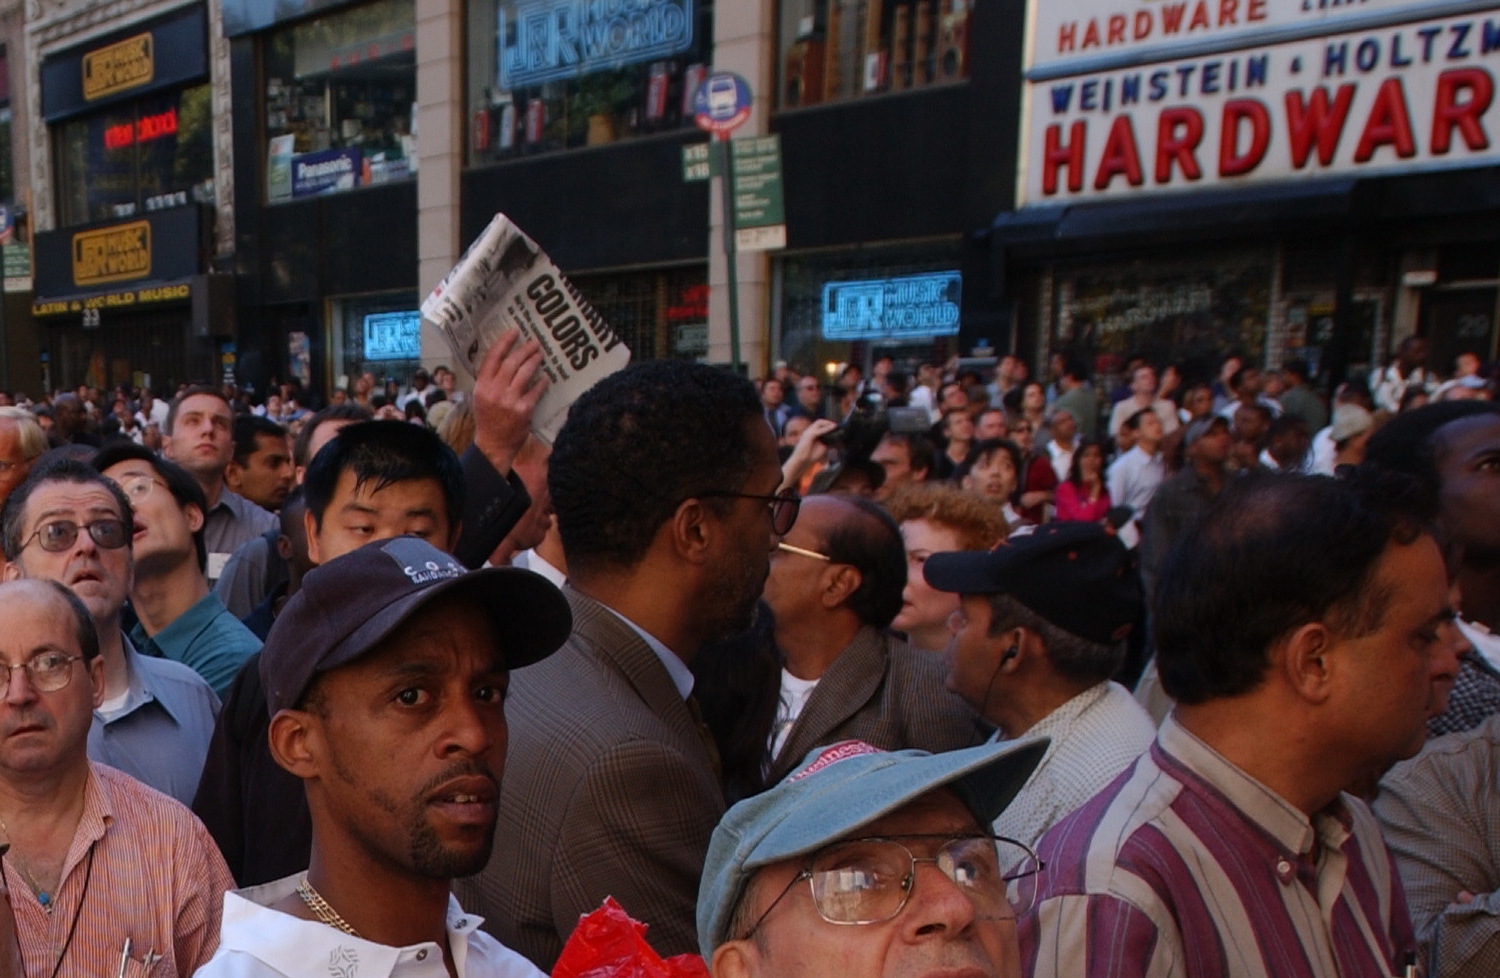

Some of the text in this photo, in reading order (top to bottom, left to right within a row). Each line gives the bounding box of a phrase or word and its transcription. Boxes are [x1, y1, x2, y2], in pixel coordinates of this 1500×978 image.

[580, 3, 685, 60] WORLD
[1057, 0, 1267, 53] HARDWARE
[1051, 54, 1269, 114] WEINSTEIN
[1043, 67, 1494, 195] HARDWAR
[298, 155, 353, 179] Panasonic
[32, 301, 68, 316] LATIN
[86, 292, 135, 309] WORLD
[139, 284, 190, 301] MUSIC
[884, 279, 949, 307] MUSIC
[884, 301, 960, 330] WORLD
[526, 273, 599, 371] COLORS
